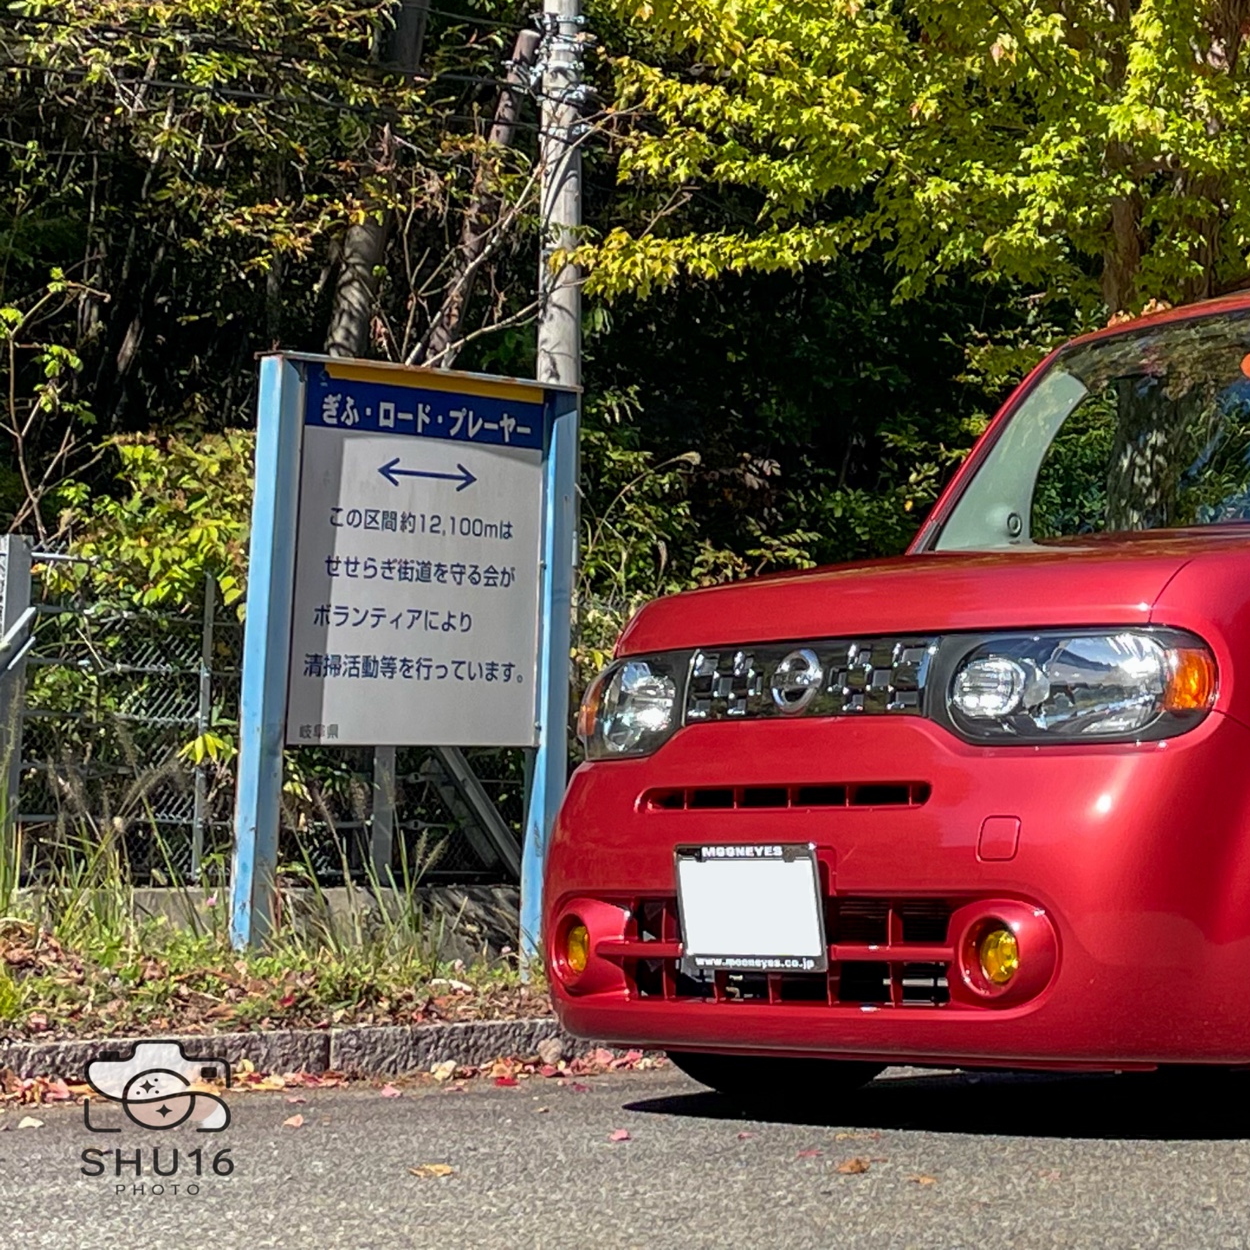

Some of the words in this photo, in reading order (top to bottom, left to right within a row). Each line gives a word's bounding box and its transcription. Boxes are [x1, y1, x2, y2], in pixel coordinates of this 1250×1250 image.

[322, 393, 533, 443] ぎふ・ロード・プレーヤー
[329, 507, 514, 540] この区間約12,100mは
[324, 556, 516, 588] せせらぎ街道を守る会が
[313, 605, 473, 634] ボランティアにより
[303, 653, 524, 684] 清掃活動等を行っています。
[701, 846, 783, 858] MOONEYES
[695, 957, 815, 970] www.mooneyes.co.jp
